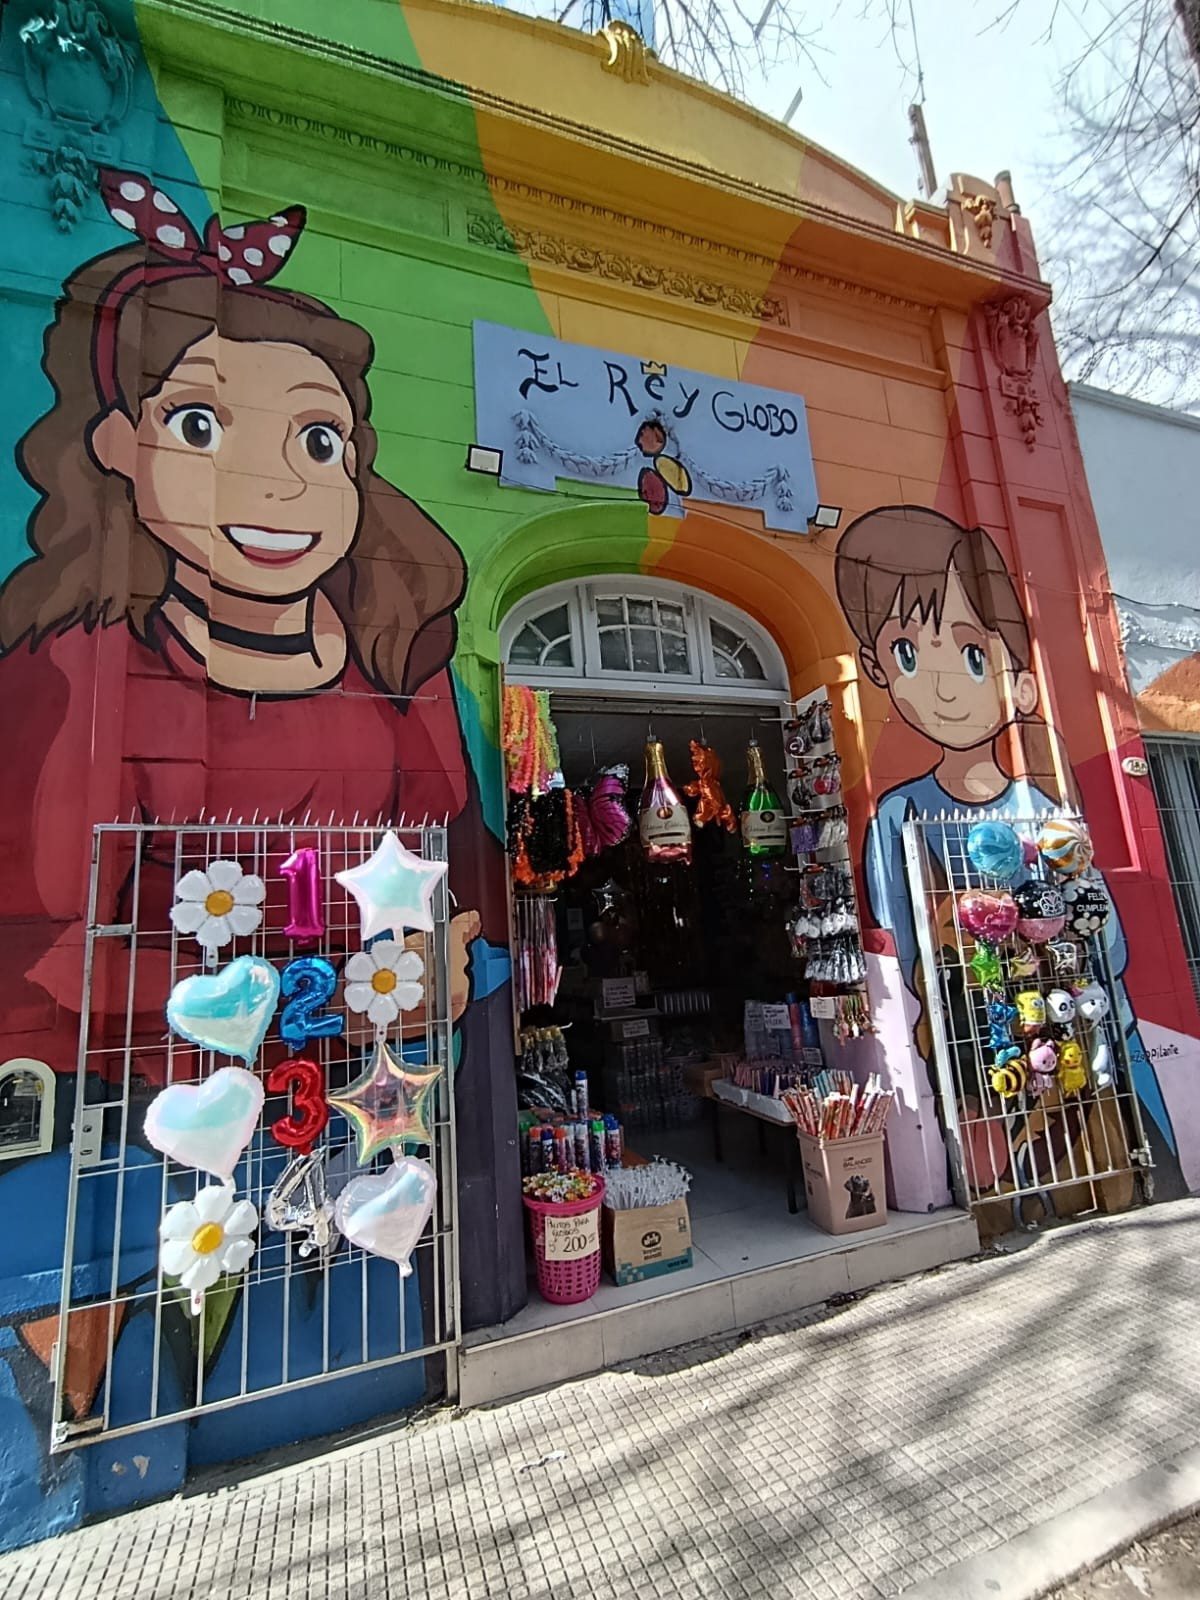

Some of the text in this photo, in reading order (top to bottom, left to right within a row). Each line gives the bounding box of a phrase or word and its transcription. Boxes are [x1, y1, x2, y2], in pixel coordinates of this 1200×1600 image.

[603, 360, 700, 417] Rey
[711, 390, 798, 437] GLOBO
[279, 846, 325, 944] 1
[279, 955, 345, 1049] 2
[266, 1058, 329, 1152] 3
[562, 1233, 588, 1253] 200
